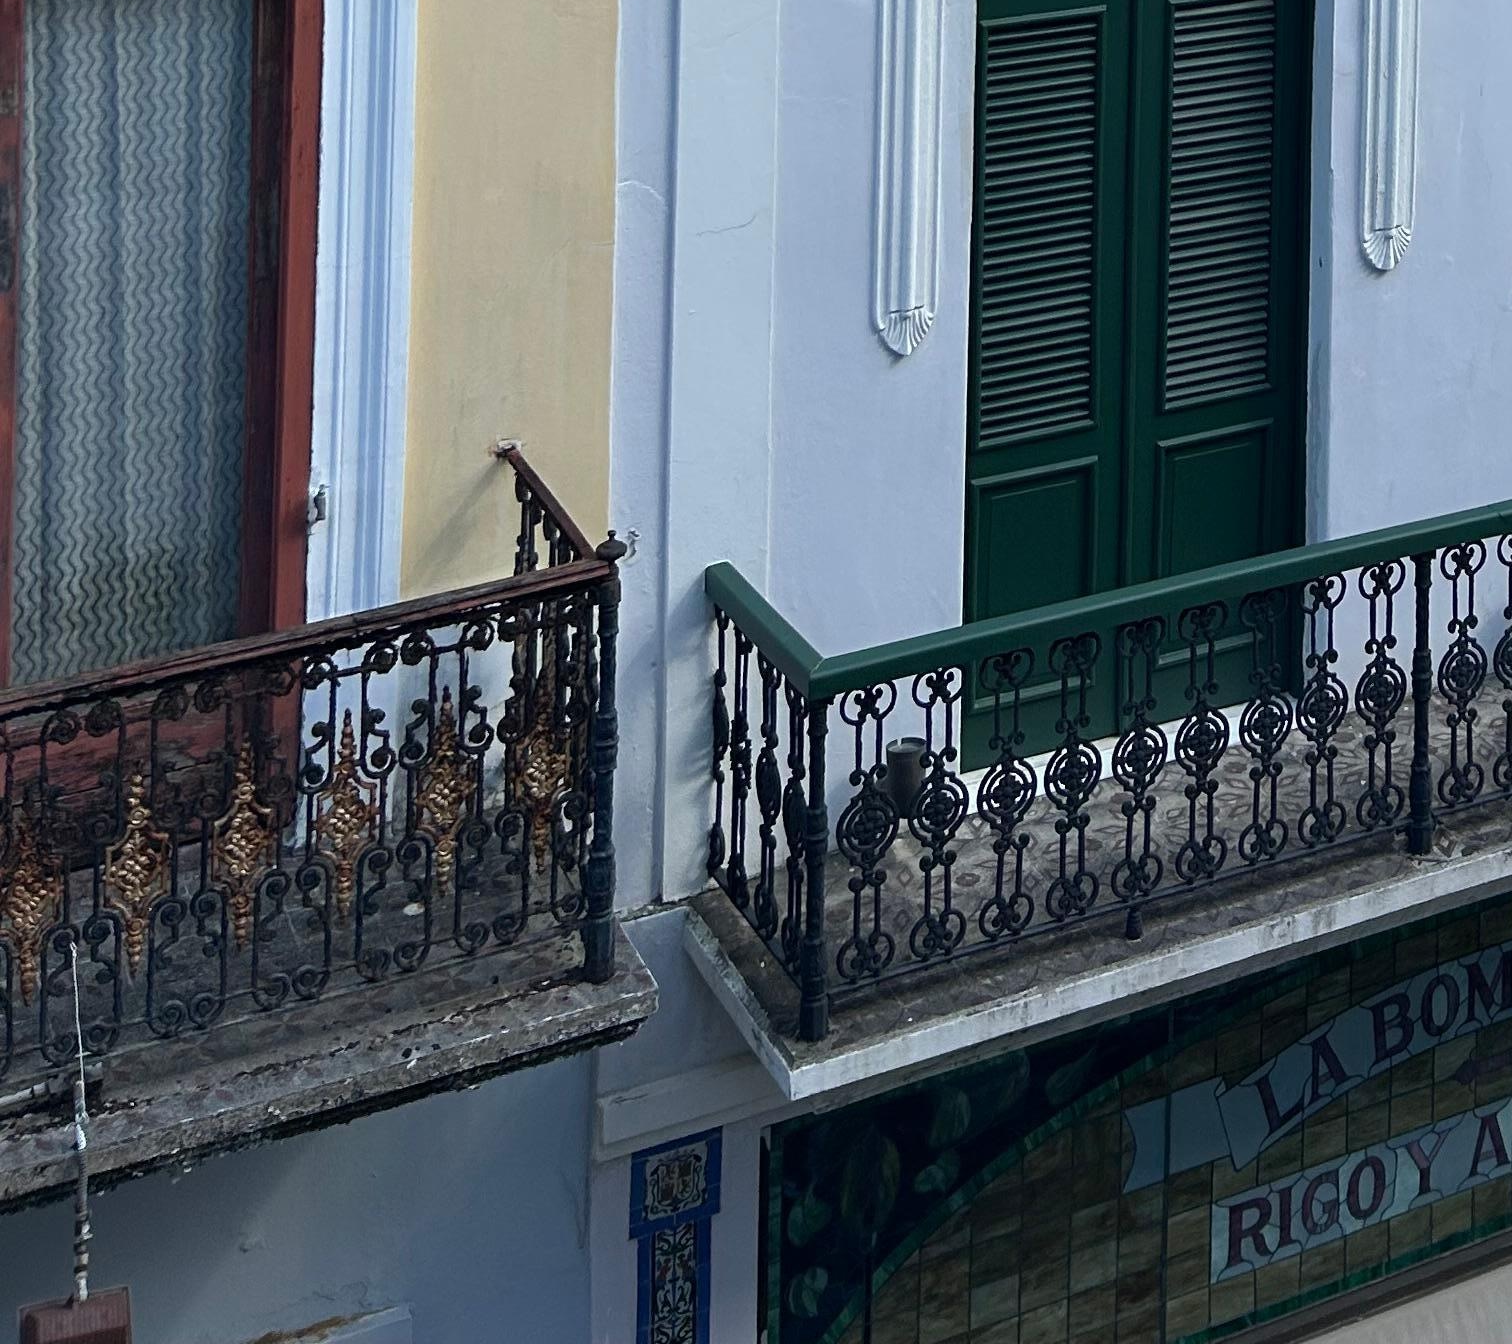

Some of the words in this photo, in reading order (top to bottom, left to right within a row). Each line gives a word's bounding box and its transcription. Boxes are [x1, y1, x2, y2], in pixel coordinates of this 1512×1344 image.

[1253, 1033, 1349, 1135] LA
[1226, 1155, 1386, 1267] RIGO
[1404, 1127, 1450, 1196] Y
